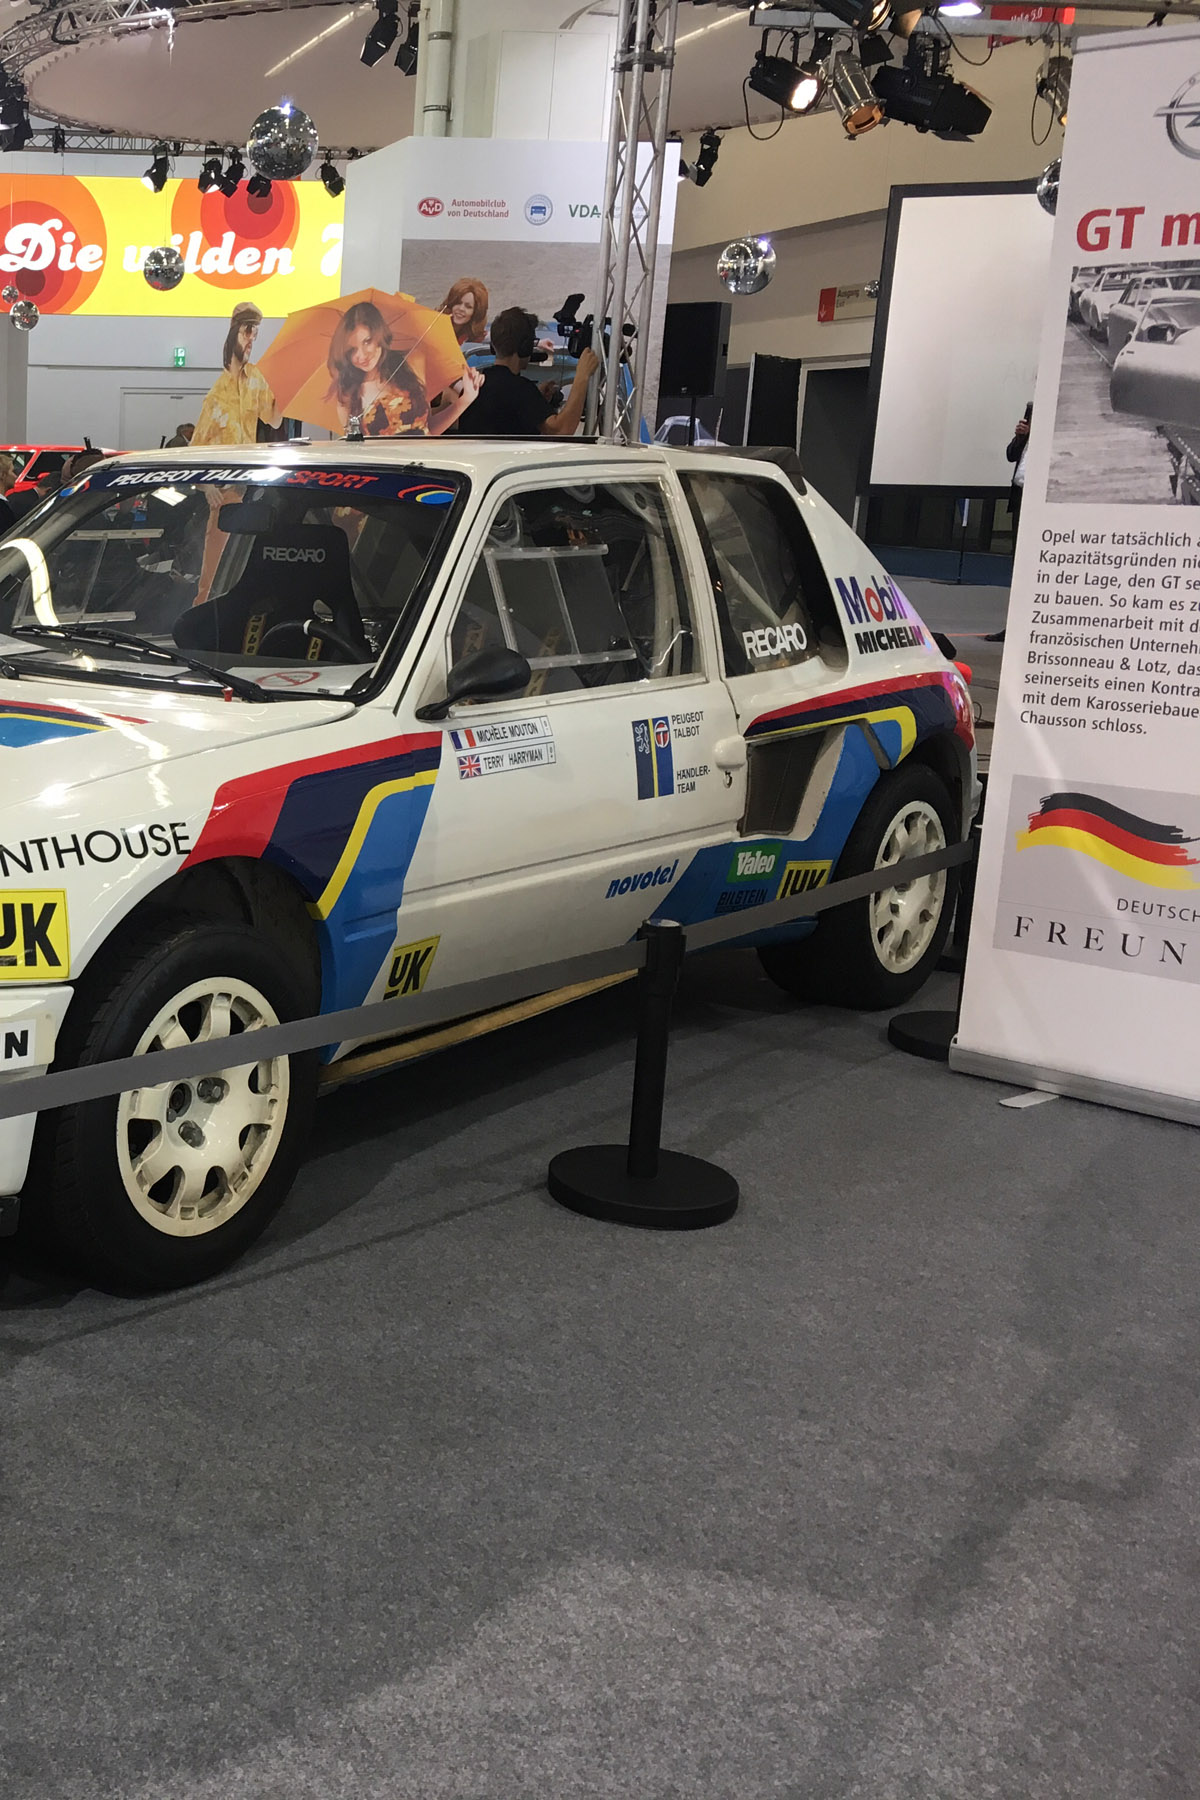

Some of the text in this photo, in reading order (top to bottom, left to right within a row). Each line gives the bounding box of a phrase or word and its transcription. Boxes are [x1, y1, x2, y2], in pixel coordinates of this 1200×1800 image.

[451, 198, 506, 208] Automobilclub
[568, 204, 601, 218] VDA
[463, 209, 509, 218] Deutschland
[1076, 206, 1146, 252] GT
[106, 467, 379, 489] PEUGEOT TALBT SPORT
[1041, 529, 1075, 546] Opel
[1080, 532, 1106, 544] war
[1111, 531, 1191, 547] tatsächlich
[263, 546, 326, 563] RECARO
[1039, 550, 1177, 569] Kapazitätsgründen
[1036, 569, 1050, 584] in
[1055, 570, 1079, 585] der
[1084, 572, 1122, 589] Lage,
[1127, 574, 1155, 588] den
[1161, 575, 1181, 589] GT
[834, 574, 907, 625] Mobil
[1034, 593, 1050, 604] zu
[1055, 591, 1103, 607] bauen.
[1109, 594, 1127, 608] So
[1132, 594, 1163, 610] kam
[1169, 600, 1184, 611] es
[1031, 611, 1153, 630] Zusammenarbeit
[1159, 617, 1184, 633] mit
[742, 622, 807, 659] RECARO
[854, 625, 927, 655] MICHELIN
[1029, 630, 1200, 654] französischen Unterneh
[1027, 650, 1114, 670] Brissonneau
[1120, 657, 1131, 671] &
[1137, 658, 1171, 676] Lotz,
[1024, 671, 1099, 689] seinerseits
[1104, 677, 1145, 693] einen
[1022, 691, 1046, 705] mit
[1050, 692, 1081, 708] dem
[671, 711, 704, 725] PEUGEOT
[1020, 710, 1147, 735] Chausson schloss.
[508, 722, 538, 738] MOUTON
[673, 725, 700, 739] TALBOT
[483, 754, 504, 770] TERRY
[508, 748, 543, 766] HARRYMAN
[677, 781, 696, 794] TEAM
[736, 850, 776, 876] Valeo
[605, 859, 680, 899] novotel
[717, 888, 768, 906] BILSTEIN
